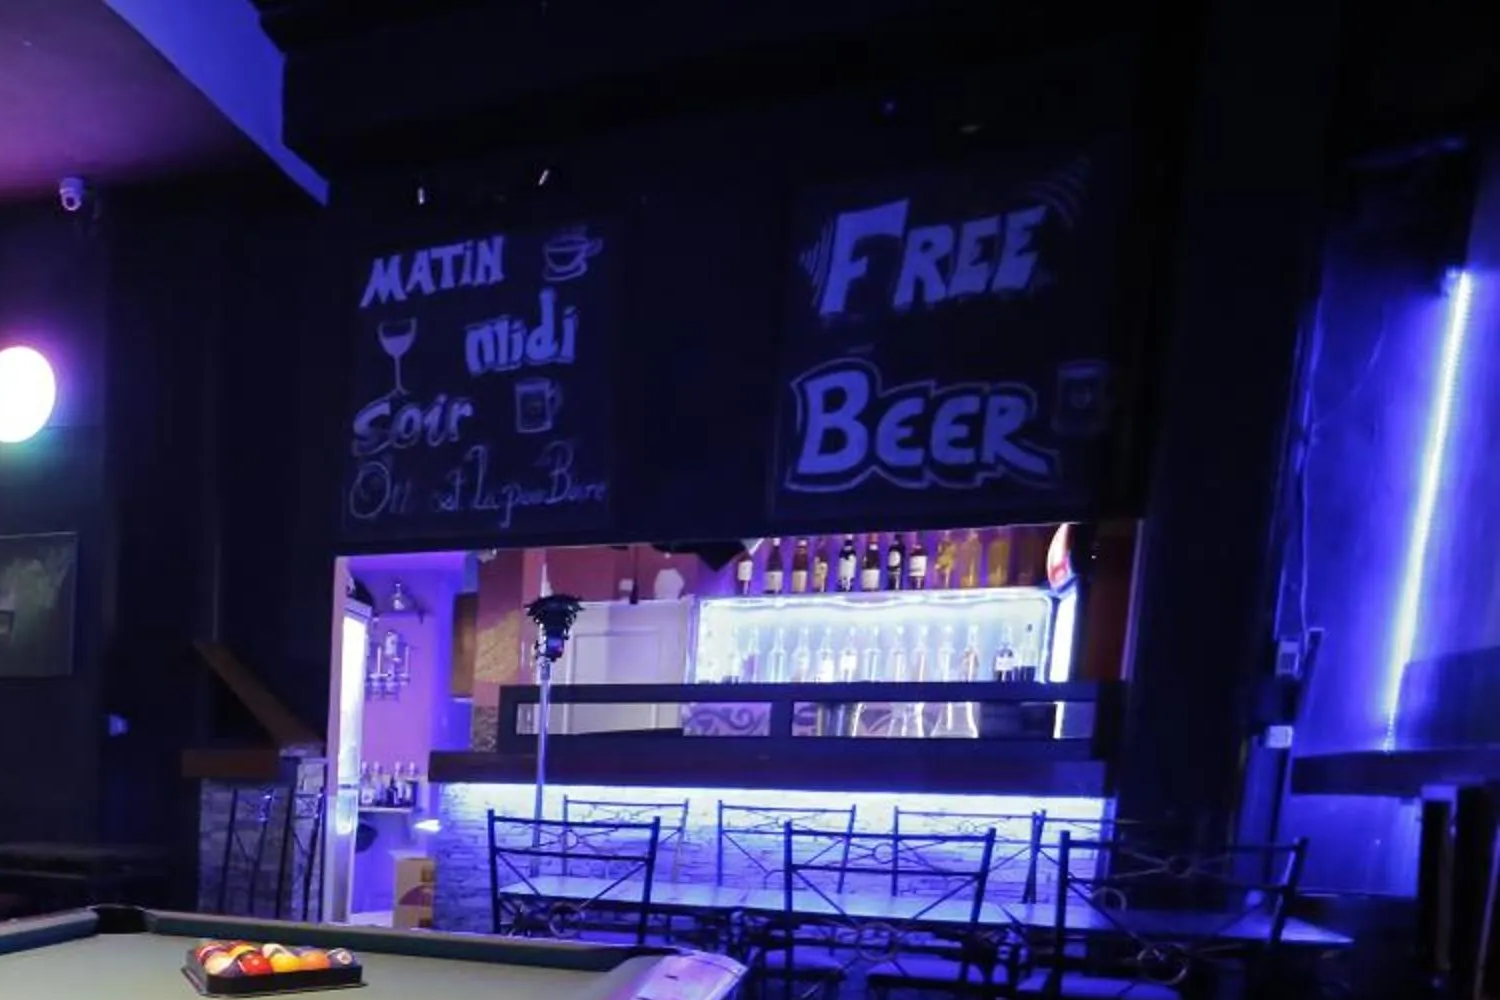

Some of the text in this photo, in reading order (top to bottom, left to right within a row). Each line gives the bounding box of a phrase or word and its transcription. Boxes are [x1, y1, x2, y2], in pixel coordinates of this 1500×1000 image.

[819, 198, 1047, 315] FREE
[352, 393, 474, 457] Soir
[790, 364, 1052, 482] BEER
